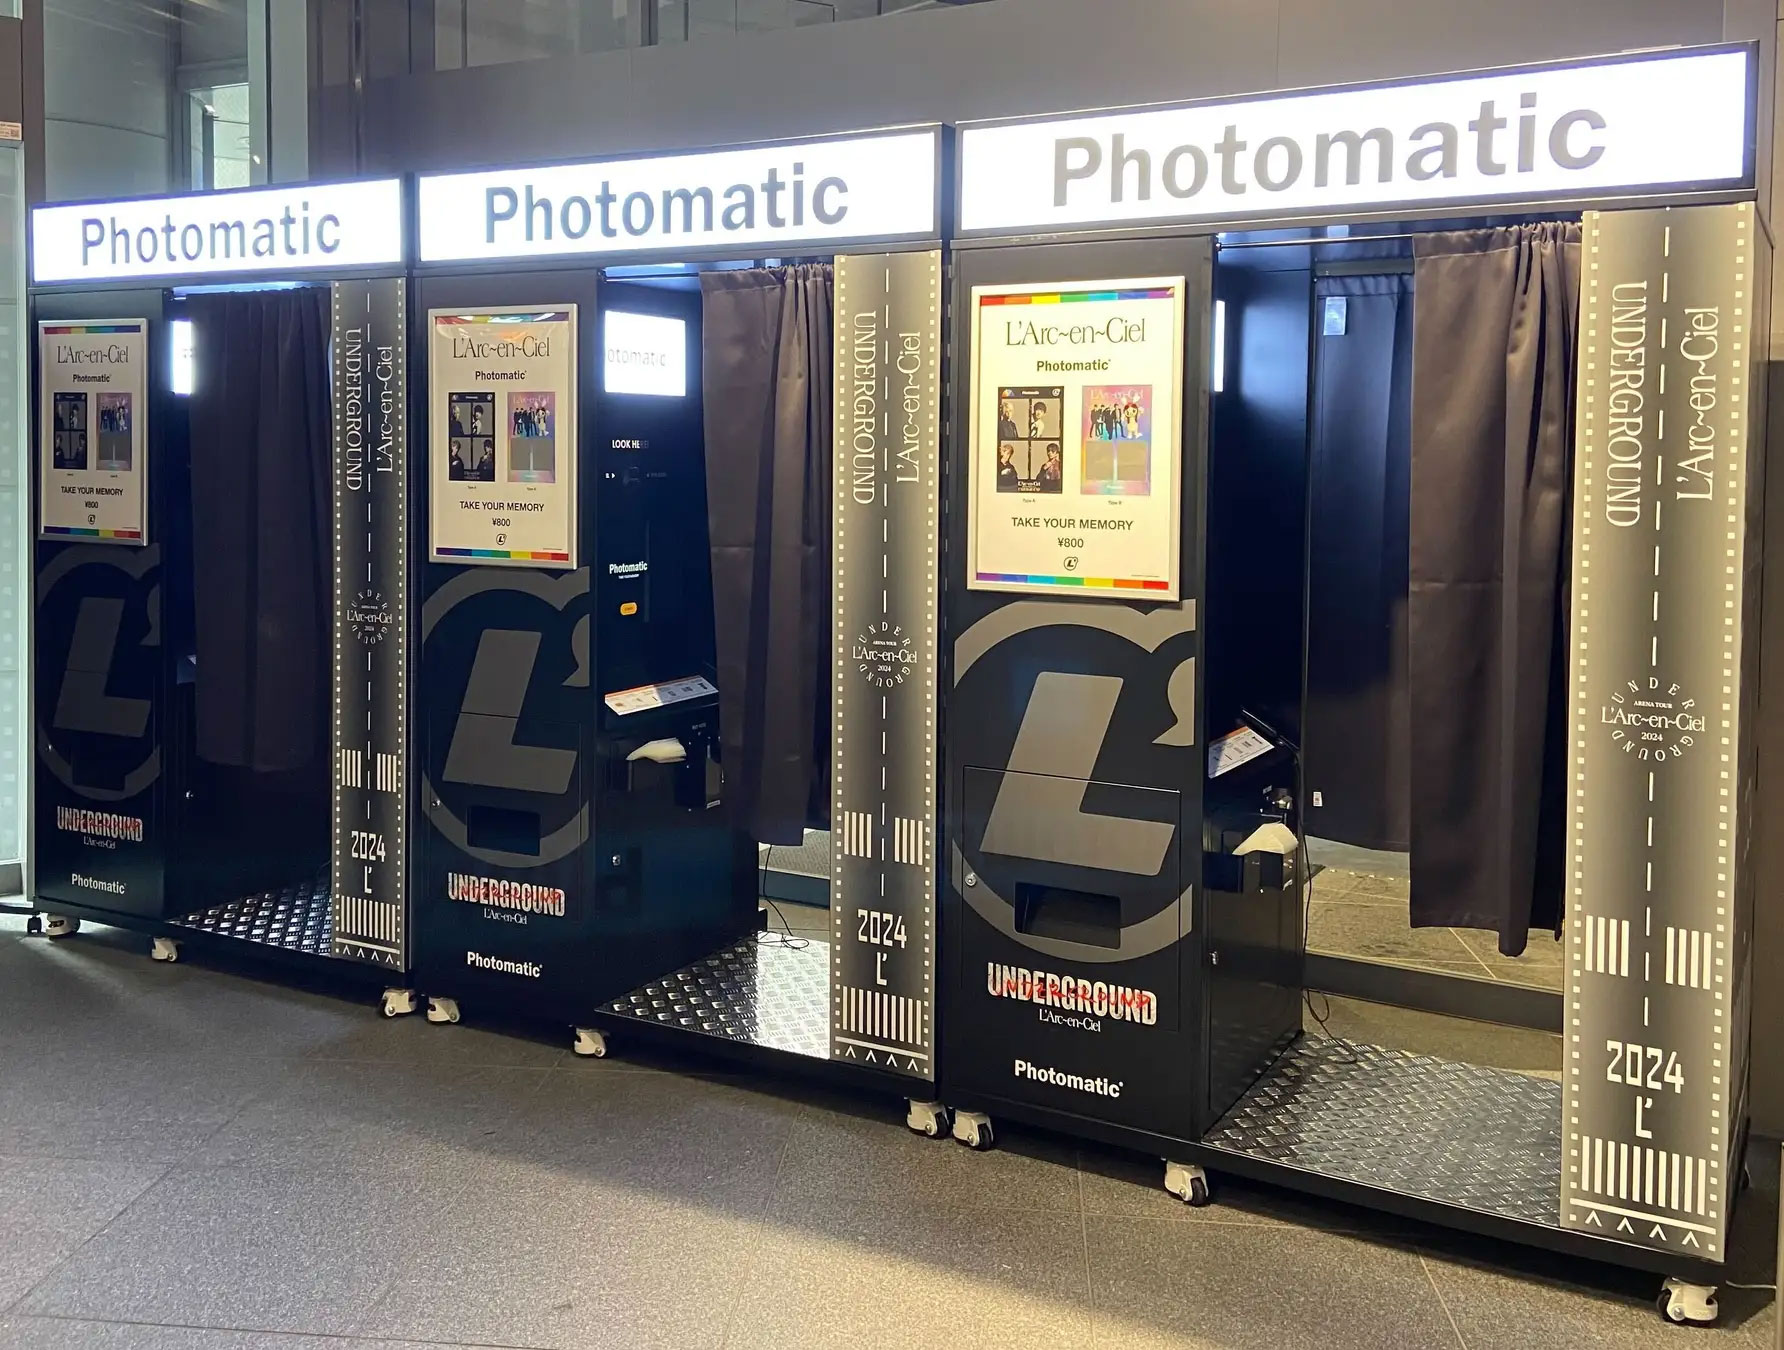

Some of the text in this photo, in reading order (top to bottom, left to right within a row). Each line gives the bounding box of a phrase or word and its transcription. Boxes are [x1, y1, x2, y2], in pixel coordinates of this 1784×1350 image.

[1053, 92, 1607, 207] Photomatic
[485, 162, 849, 243] Photomatic
[81, 201, 341, 266] Photomatic
[1006, 317, 1146, 346] L'Arc~en~Ciel
[453, 336, 550, 358] L'Arc~en~Ciel
[475, 370, 526, 381] Photomatic
[1036, 359, 1110, 372] Photomatic
[345, 328, 362, 491] UNDERGROUND
[853, 310, 876, 505] UNDERGROUND
[896, 332, 921, 483] L'Arc~en~Ciel
[1606, 280, 1648, 528] UNDERGROUND
[1676, 306, 1719, 500] L'Arc~en~Ciel
[612, 440, 631, 449] LOOK
[60, 486, 124, 496] TAKE YOUR MEMORY
[460, 501, 544, 512] TAKE YOUR MEMORY
[492, 518, 511, 526] ¥800
[1012, 517, 1134, 530] TAKE YOUR MEMORY
[1058, 538, 1084, 548] ¥800
[609, 561, 648, 574] Photomatic
[1601, 706, 1706, 732] L'Arc~en~Ciel
[1641, 732, 1663, 742] 2024
[57, 806, 143, 842] UNDERGROUND
[351, 830, 386, 862] 2024
[72, 873, 126, 894] Photomatic
[448, 872, 566, 917] UNDERGROUND
[858, 908, 907, 949] 2024
[467, 951, 541, 978] Photomatic
[988, 962, 1157, 1026] UNDERGROUND
[1014, 1059, 1121, 1098] Photomatic
[1606, 1040, 1685, 1094] 2024
